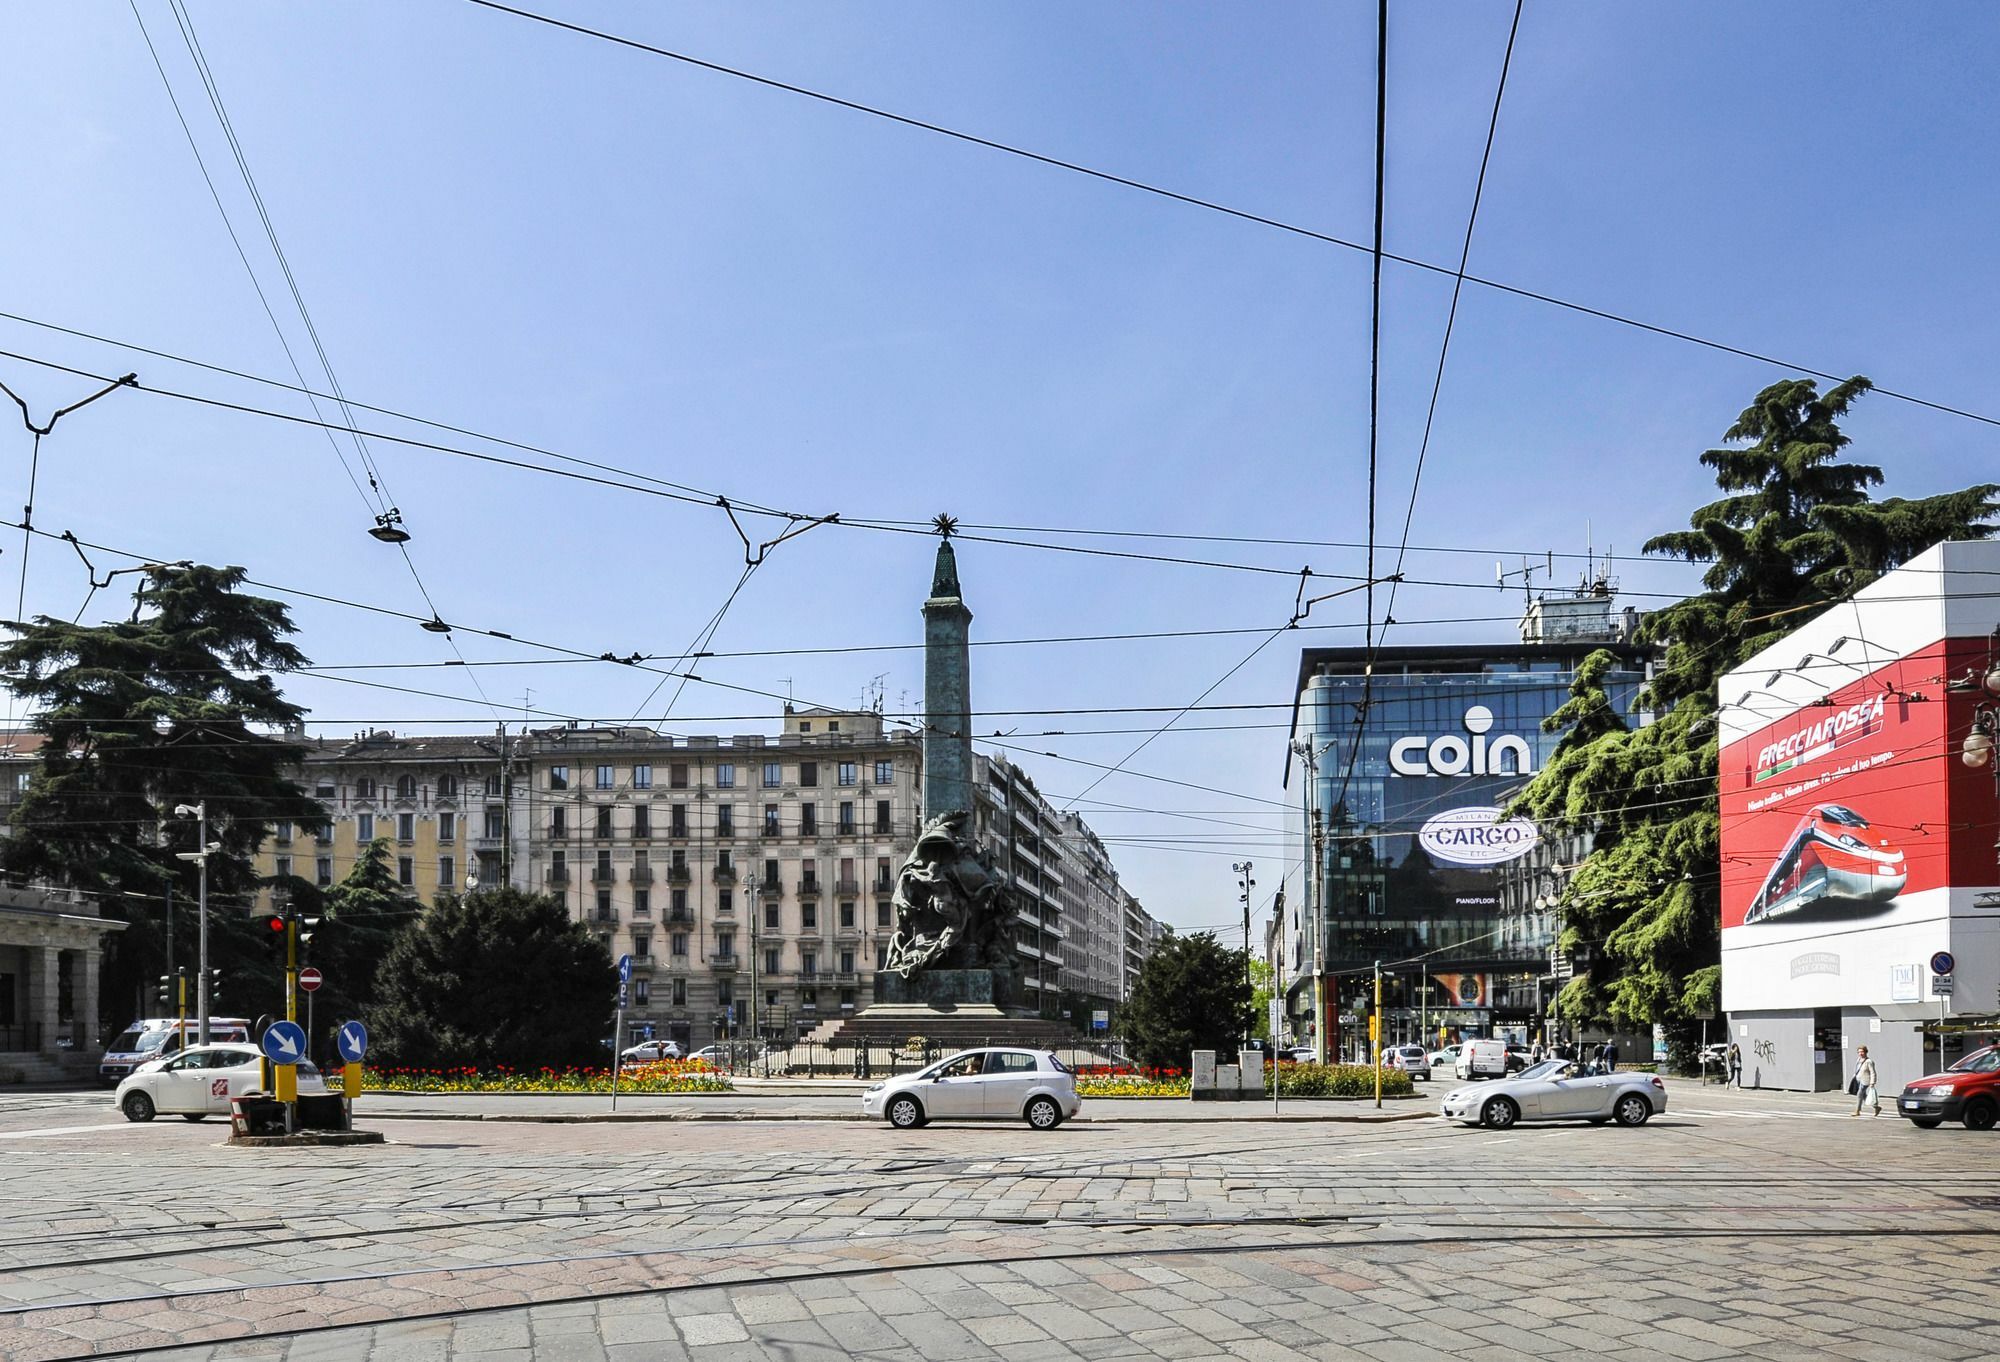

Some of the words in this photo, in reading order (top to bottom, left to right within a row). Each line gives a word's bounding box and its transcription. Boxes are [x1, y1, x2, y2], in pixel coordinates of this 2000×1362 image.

[1390, 705, 1531, 775] coin
[1757, 693, 1884, 770] FRECCIAROSSA
[1436, 827, 1521, 845] CARGO
[1338, 1010, 1358, 1024] coin
